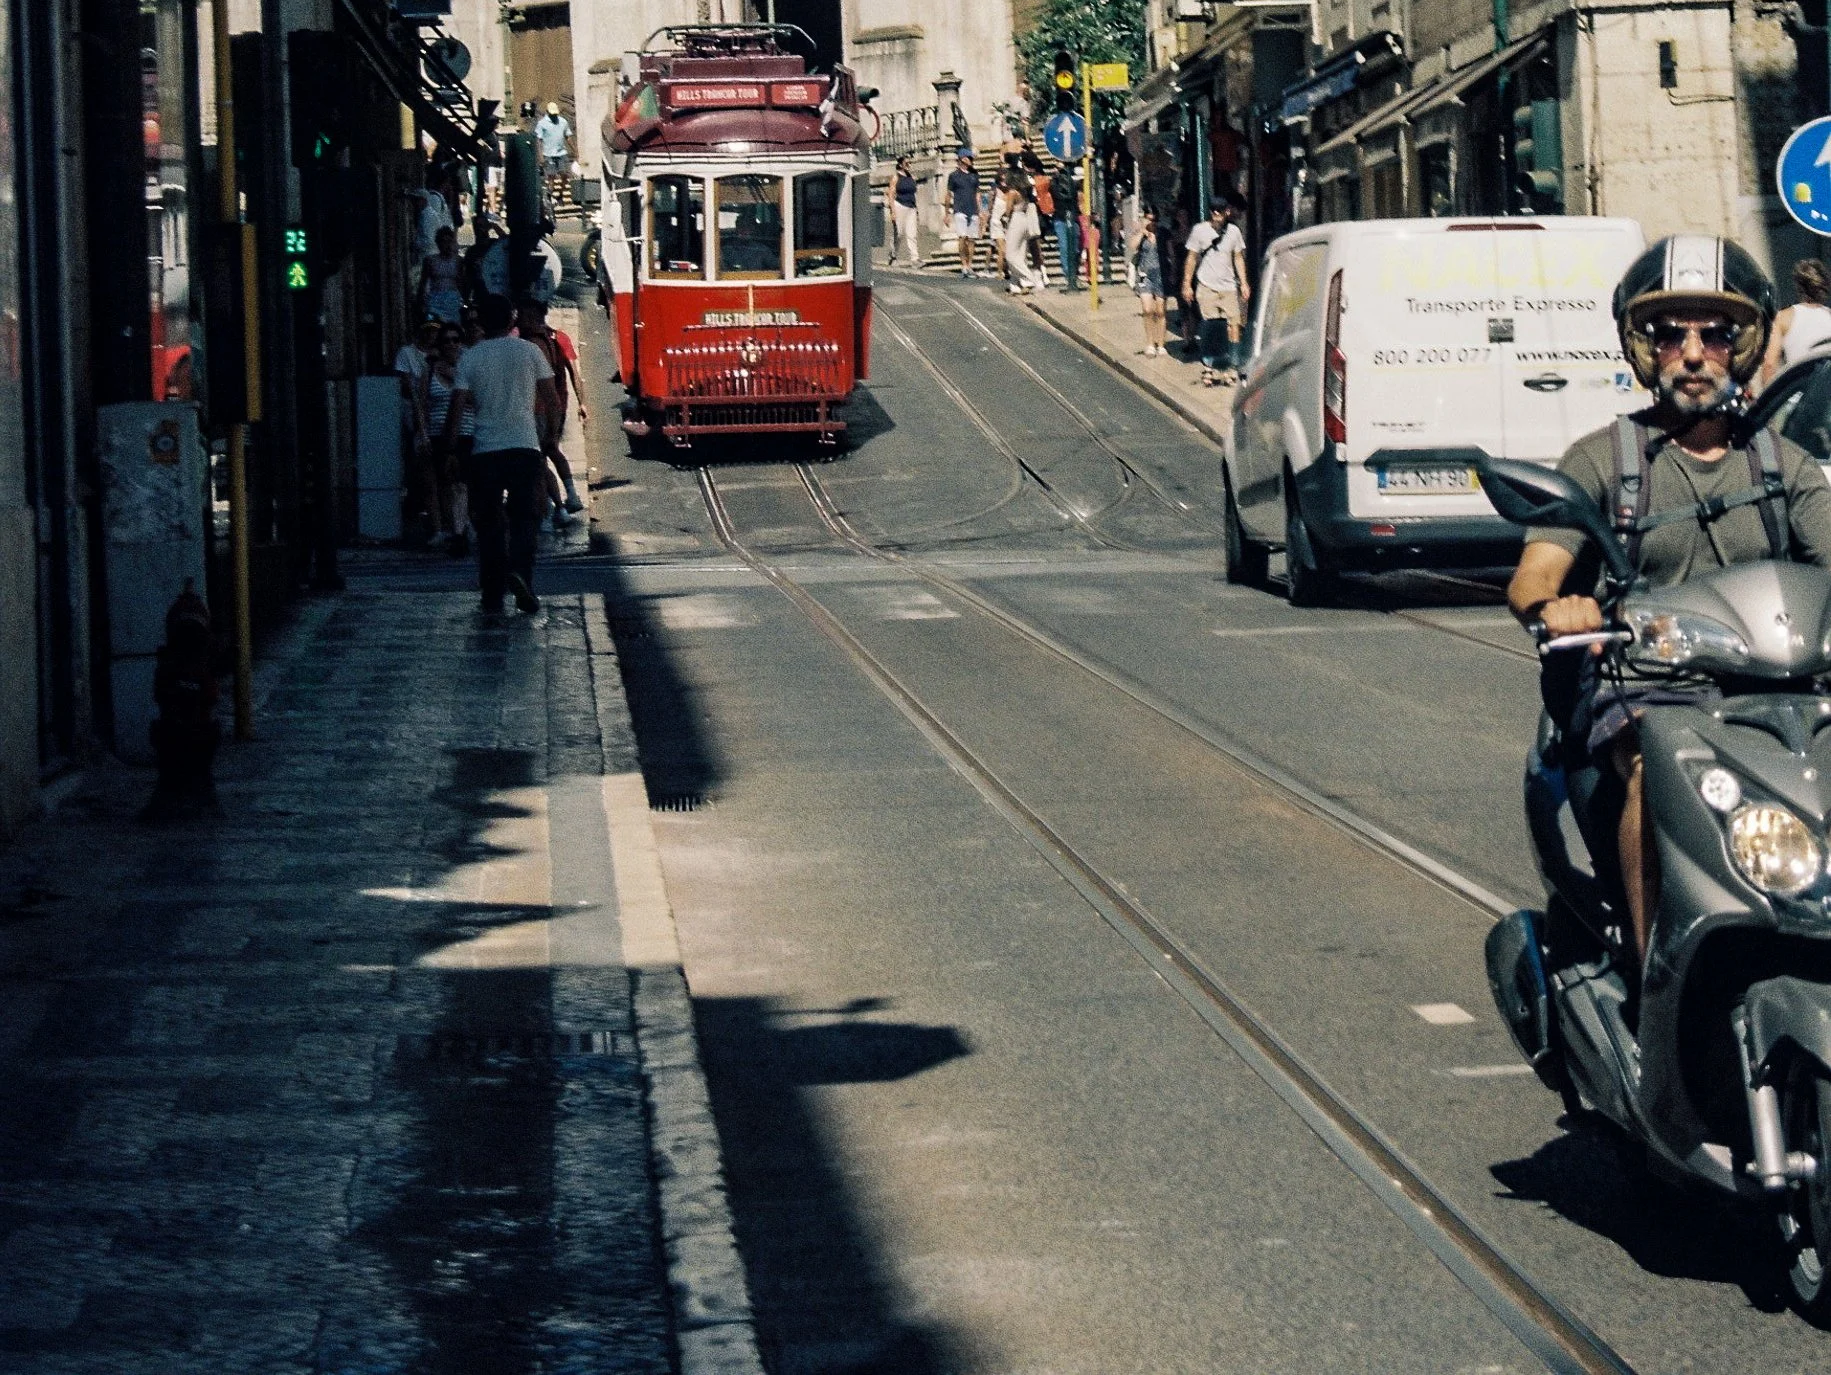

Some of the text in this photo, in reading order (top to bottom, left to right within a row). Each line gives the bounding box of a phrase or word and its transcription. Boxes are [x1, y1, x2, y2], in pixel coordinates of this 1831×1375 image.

[1406, 295, 1597, 316] Transporte Expresso
[1374, 347, 1492, 366] 800 200 077
